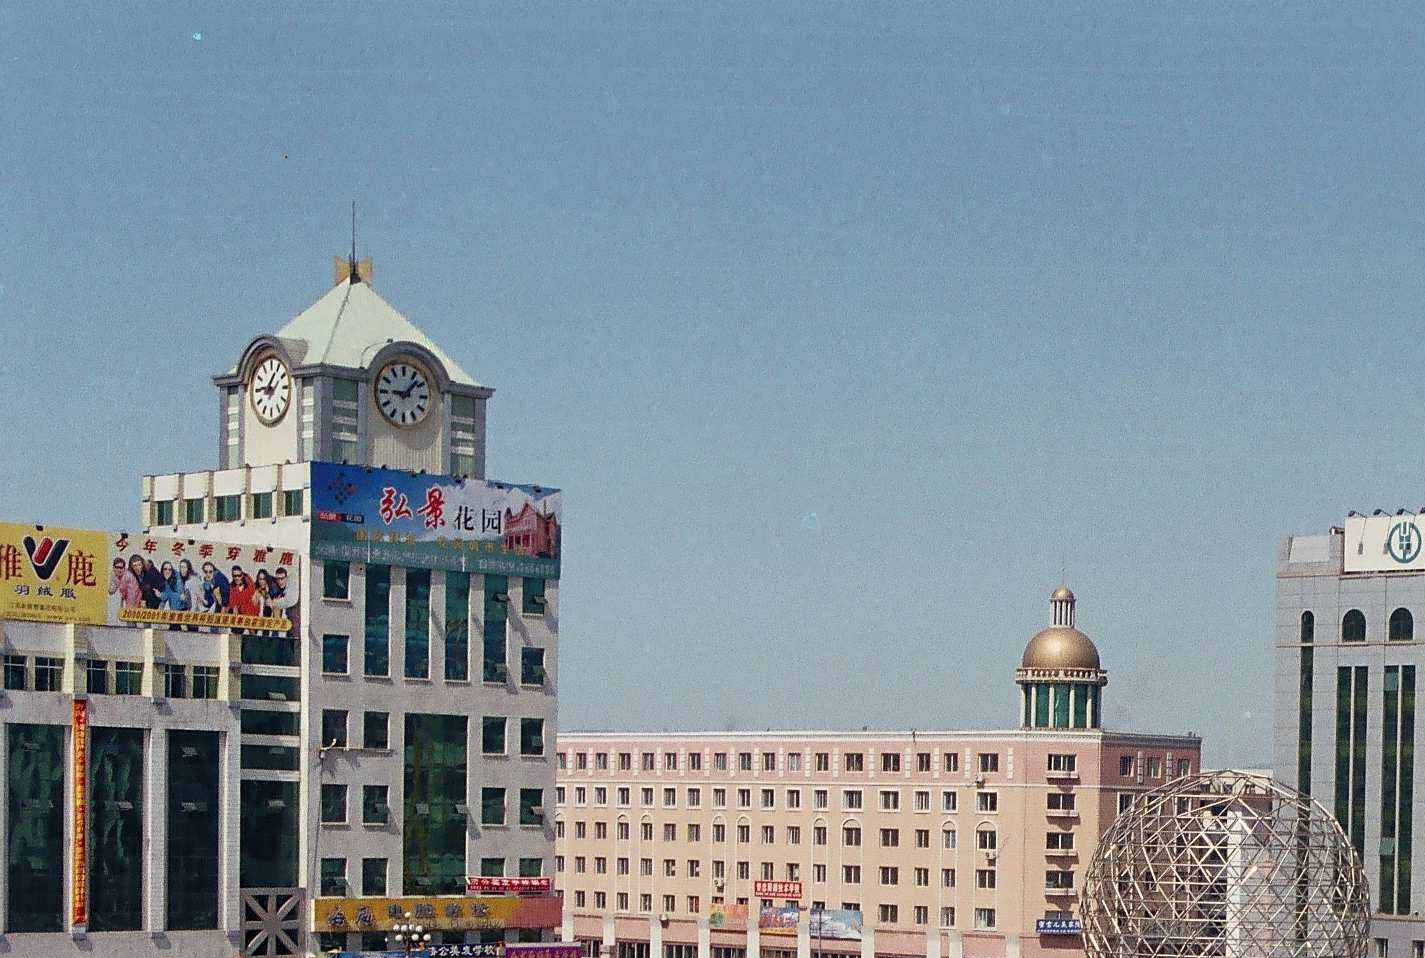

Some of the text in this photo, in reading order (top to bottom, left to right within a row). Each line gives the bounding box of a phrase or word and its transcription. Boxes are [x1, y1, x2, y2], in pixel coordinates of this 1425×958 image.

[116, 537, 295, 566] 今年冬季穿雅鹿
